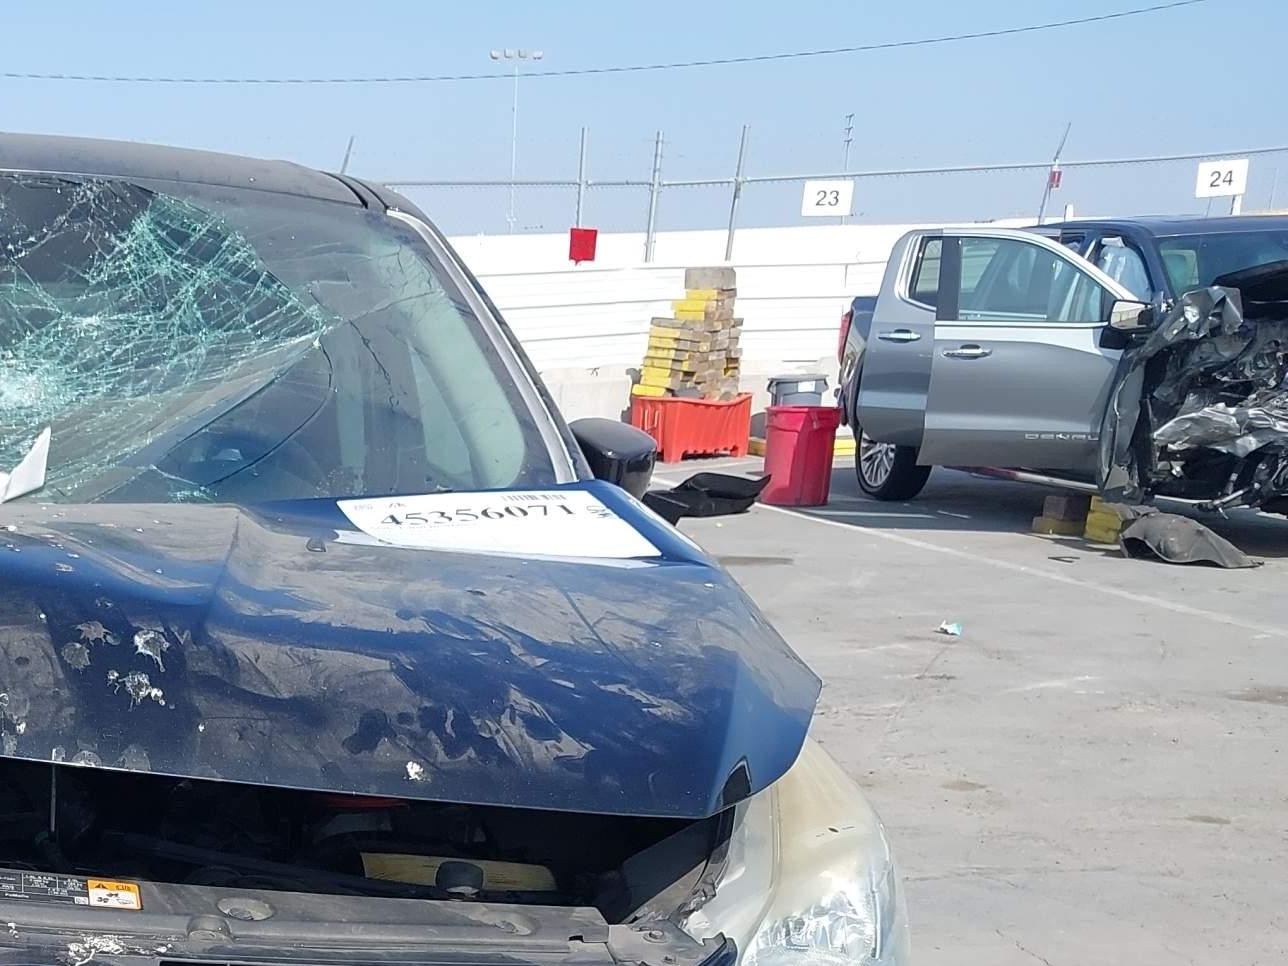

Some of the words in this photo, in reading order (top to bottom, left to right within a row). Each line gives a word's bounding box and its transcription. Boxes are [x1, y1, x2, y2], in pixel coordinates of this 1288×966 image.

[1209, 170, 1233, 188] 24
[815, 190, 840, 207] 23
[380, 504, 577, 526] 45356071
